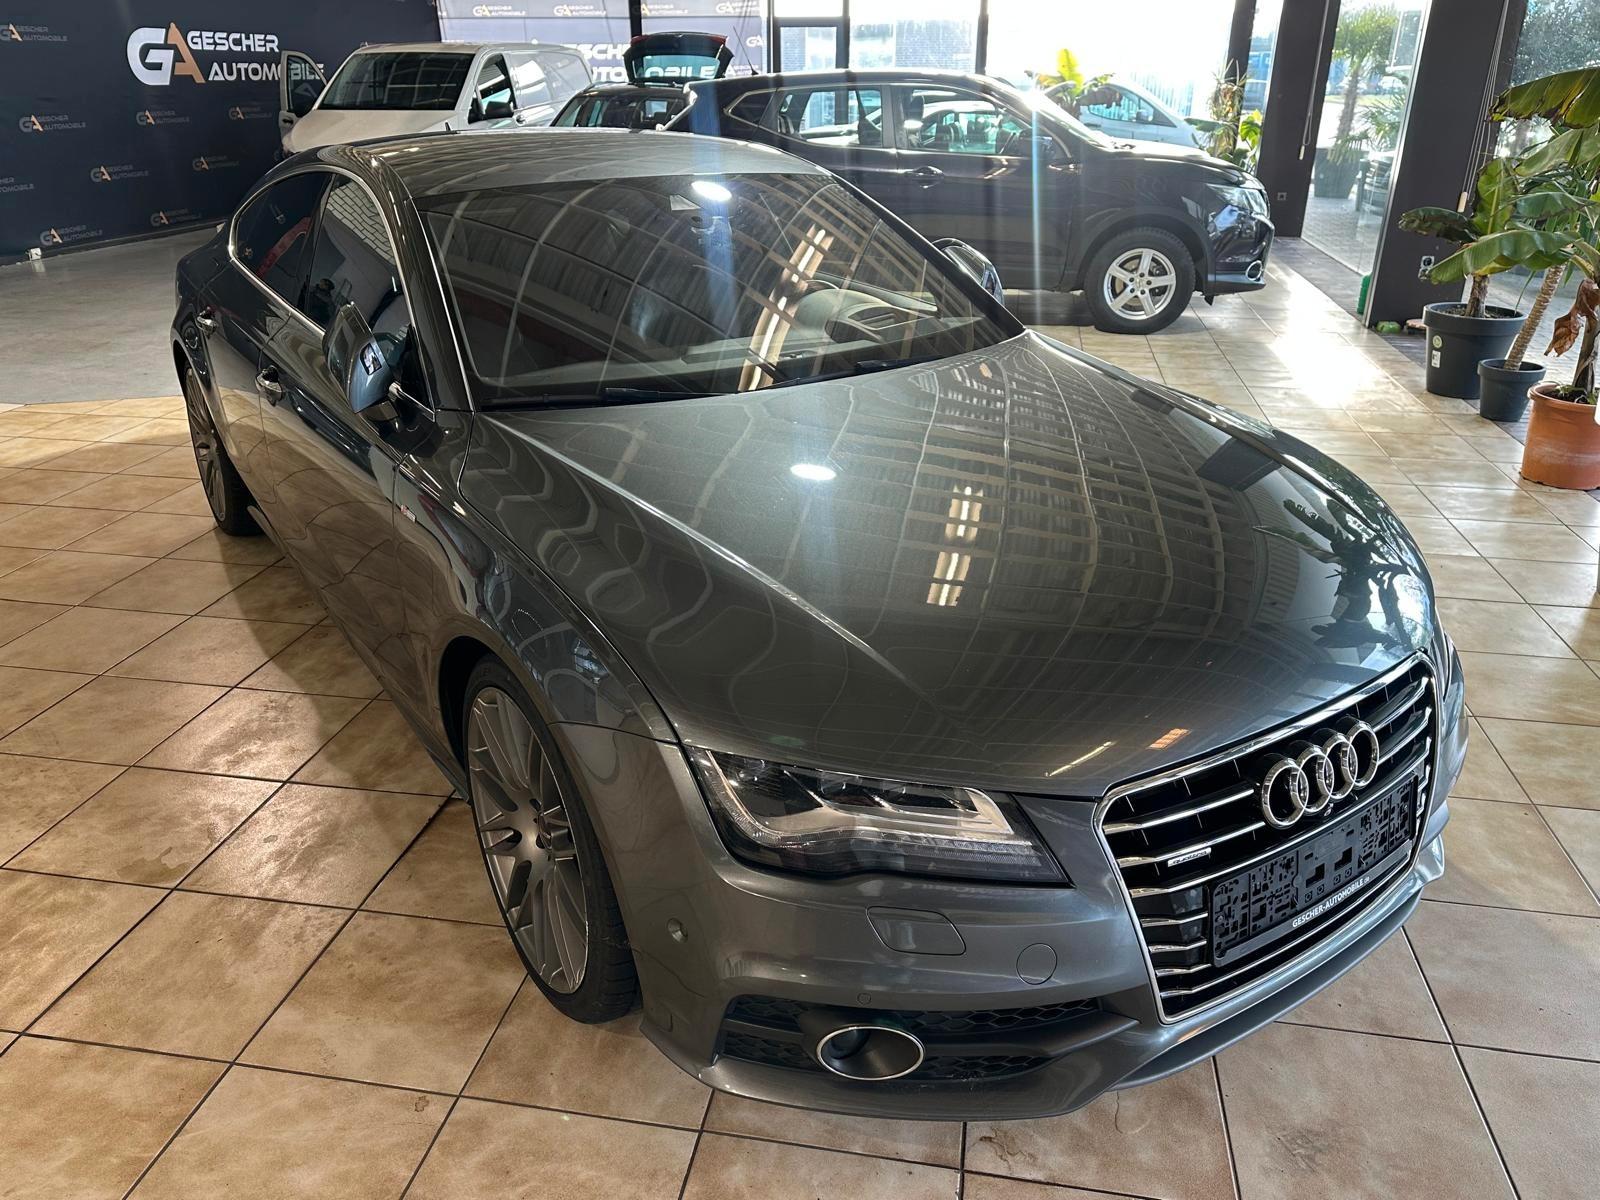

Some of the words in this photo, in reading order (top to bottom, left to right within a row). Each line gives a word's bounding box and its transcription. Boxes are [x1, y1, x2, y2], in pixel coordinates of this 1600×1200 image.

[472, 4, 491, 16] GA
[553, 4, 572, 16] GA
[186, 30, 279, 52] GESCHER
[127, 22, 206, 86] GA
[19, 114, 44, 132] GA
[136, 109, 155, 125] GA
[90, 165, 112, 182] GA
[40, 228, 63, 246] GA
